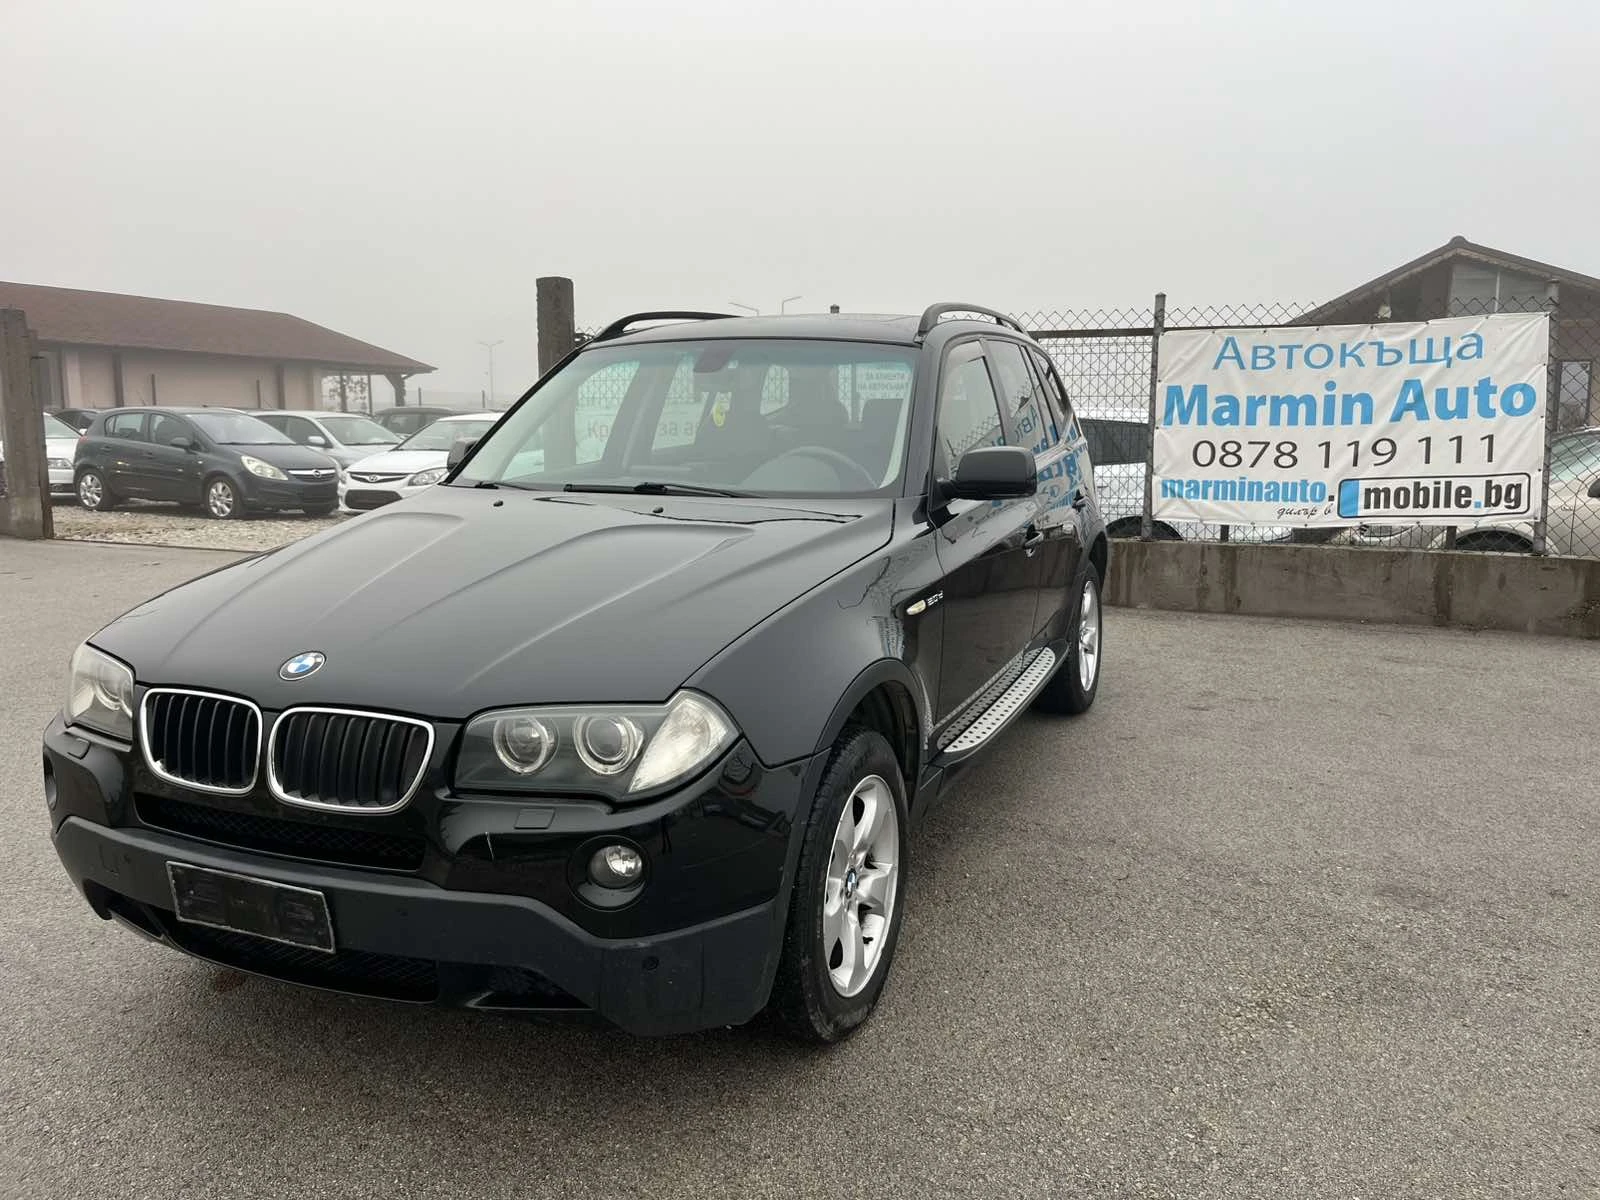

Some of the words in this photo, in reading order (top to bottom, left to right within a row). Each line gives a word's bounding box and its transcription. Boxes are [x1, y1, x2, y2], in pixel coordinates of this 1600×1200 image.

[1213, 332, 1485, 371] Автокъща
[1163, 381, 1374, 427] Marmin
[1390, 377, 1537, 423] Auto
[1192, 440, 1298, 468] 0878
[1318, 438, 1397, 468] 119
[1418, 434, 1495, 465] 111
[1363, 480, 1522, 510] mobile.bg
